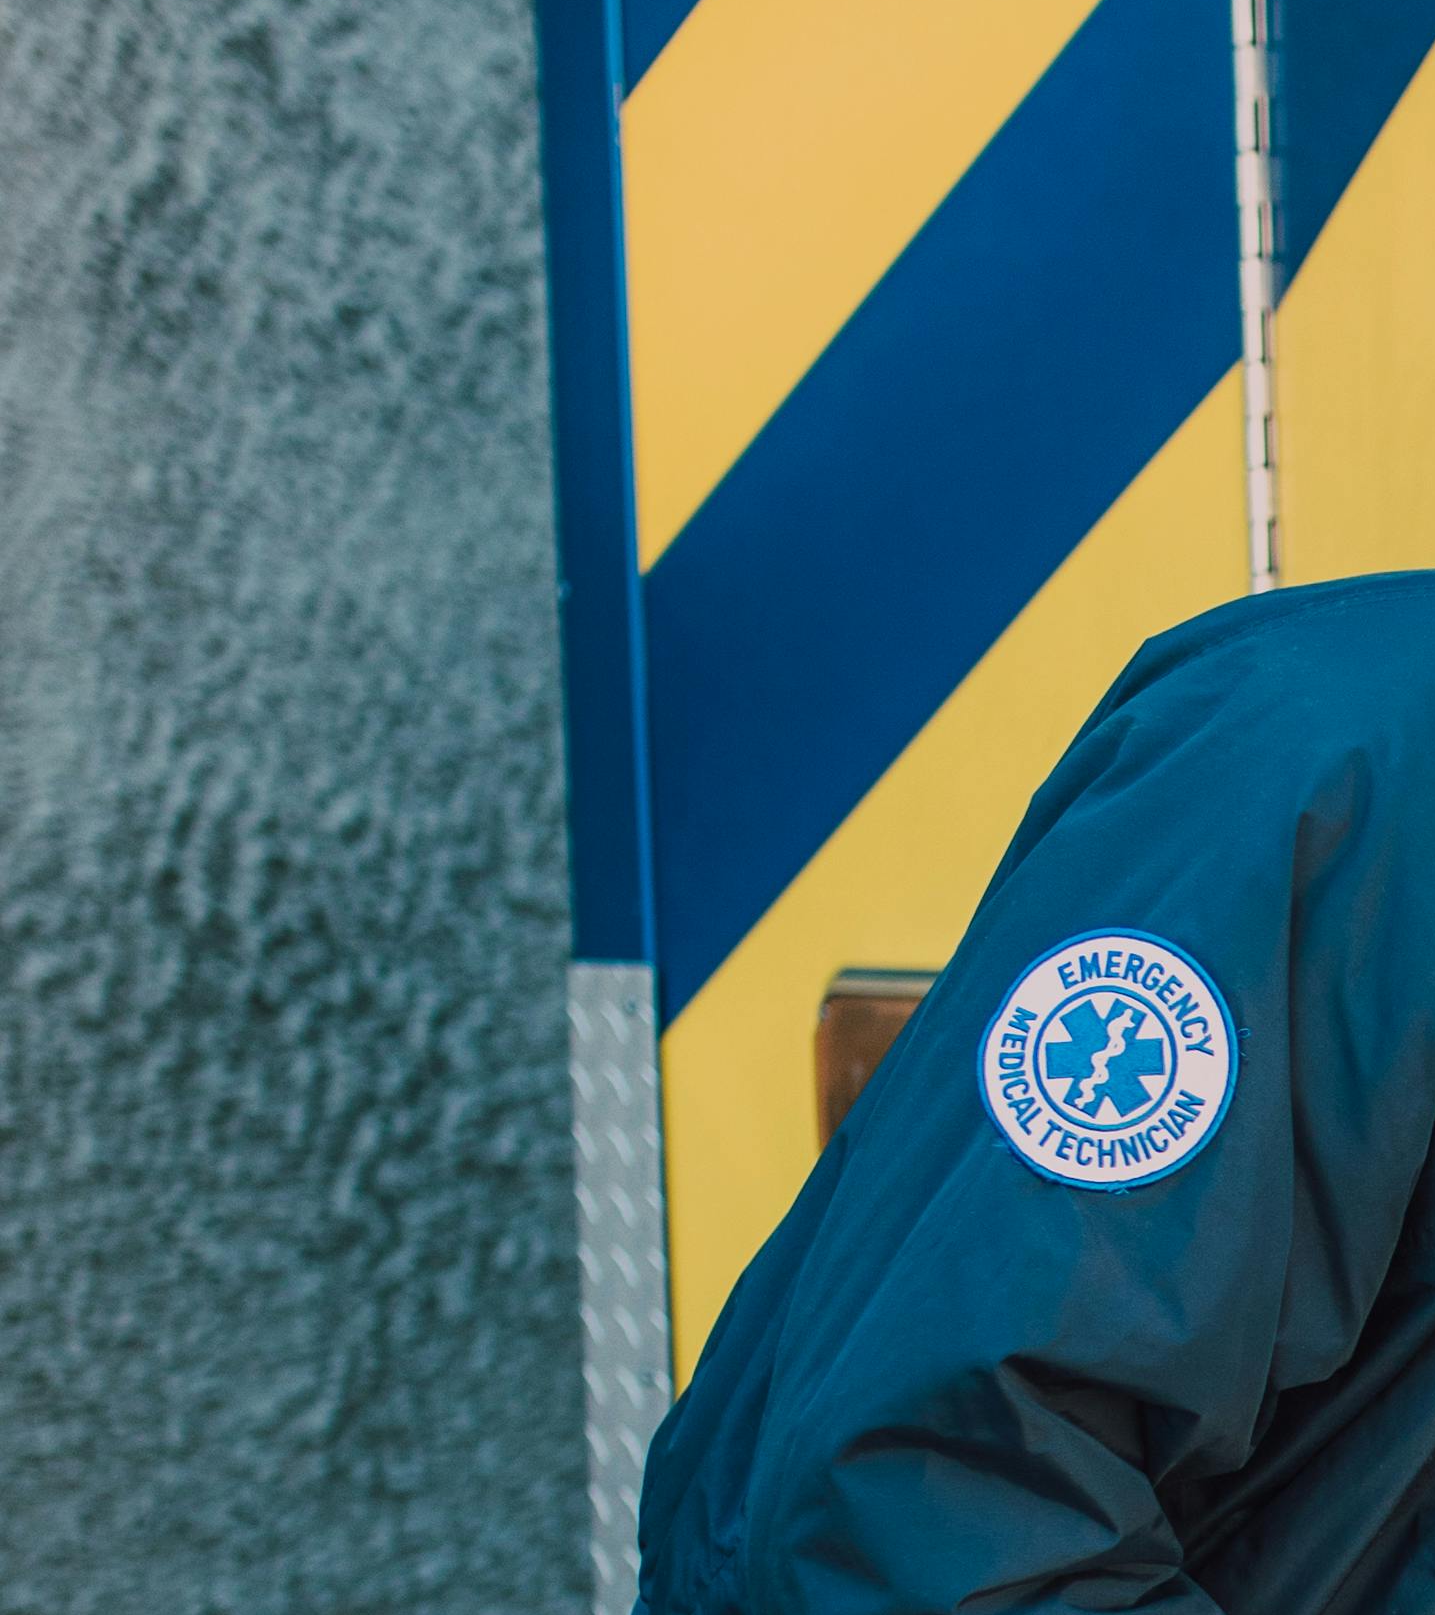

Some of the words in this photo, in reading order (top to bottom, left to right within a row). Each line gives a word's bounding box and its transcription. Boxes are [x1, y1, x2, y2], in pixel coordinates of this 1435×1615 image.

[1057, 950, 1214, 1057] EMERGENCY
[999, 1006, 1043, 1136] MEDICAL
[1038, 1089, 1206, 1168] TECHNICIAN
